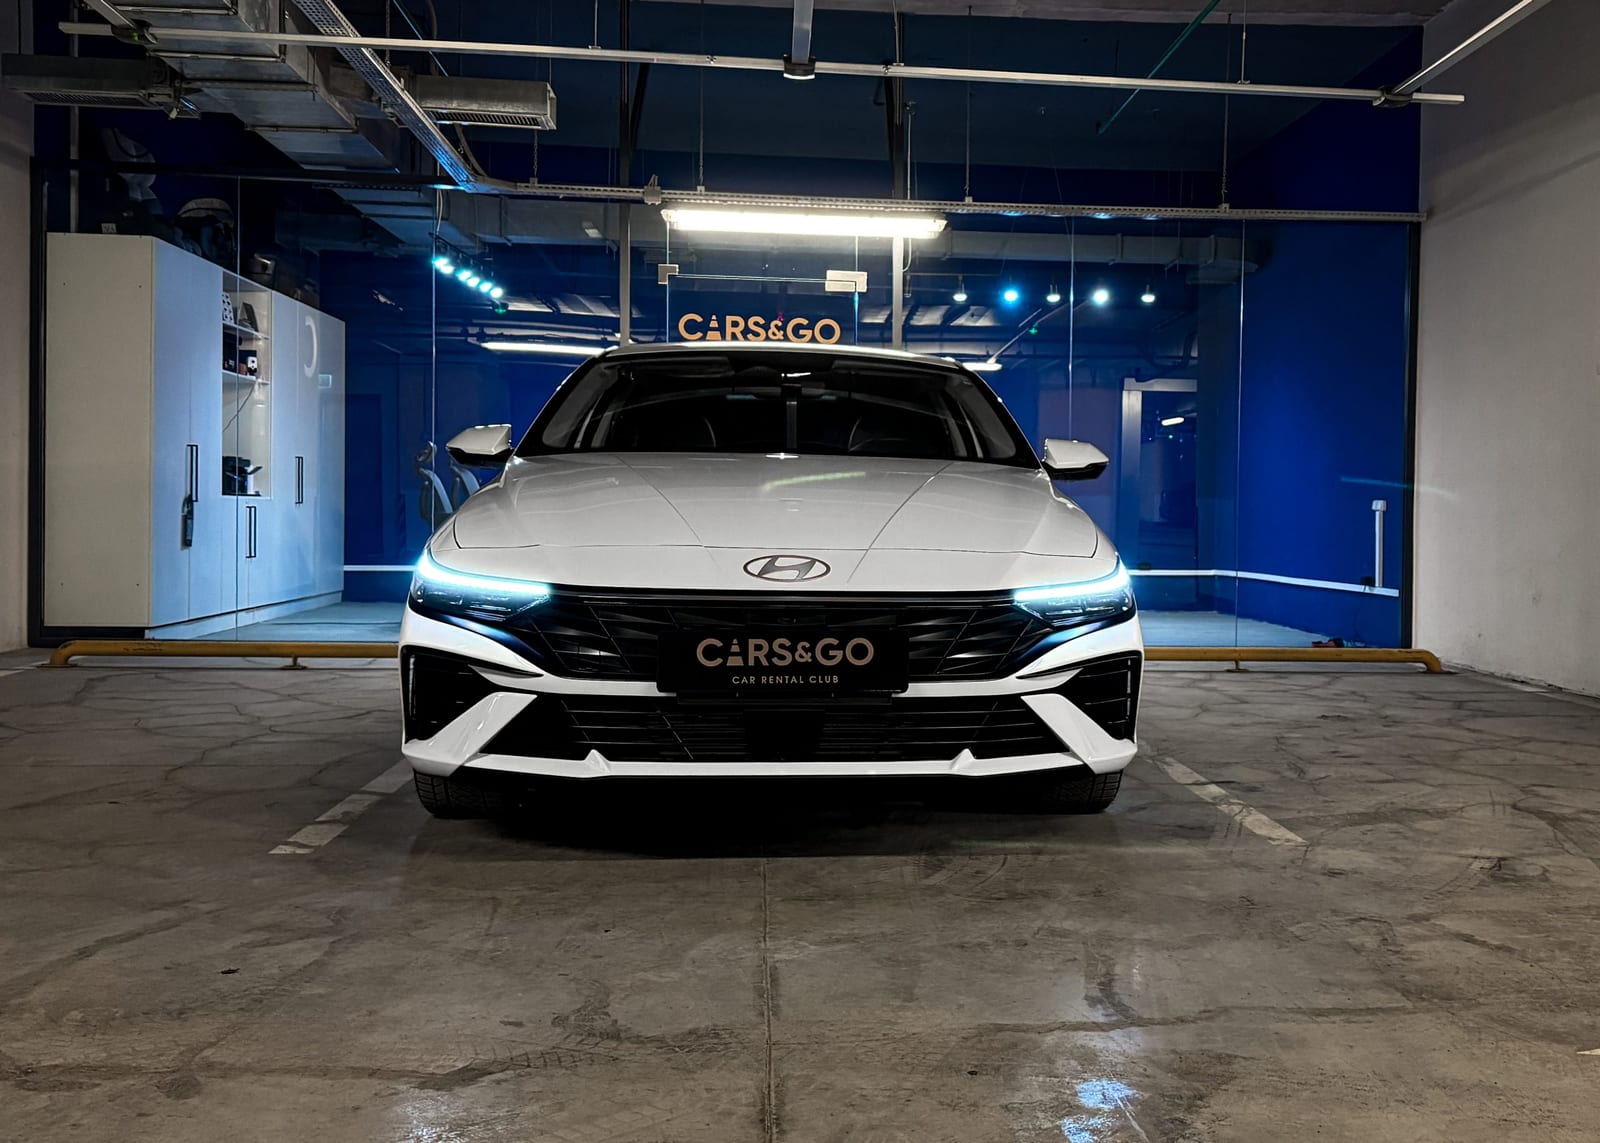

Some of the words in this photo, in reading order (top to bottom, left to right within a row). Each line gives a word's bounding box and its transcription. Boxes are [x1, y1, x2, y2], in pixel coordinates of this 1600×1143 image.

[678, 313, 841, 344] CARS&GO
[696, 637, 874, 667] CARS&GO
[732, 676, 755, 684] CAR
[761, 676, 804, 684] RENTAL
[809, 675, 839, 684] CLUB
